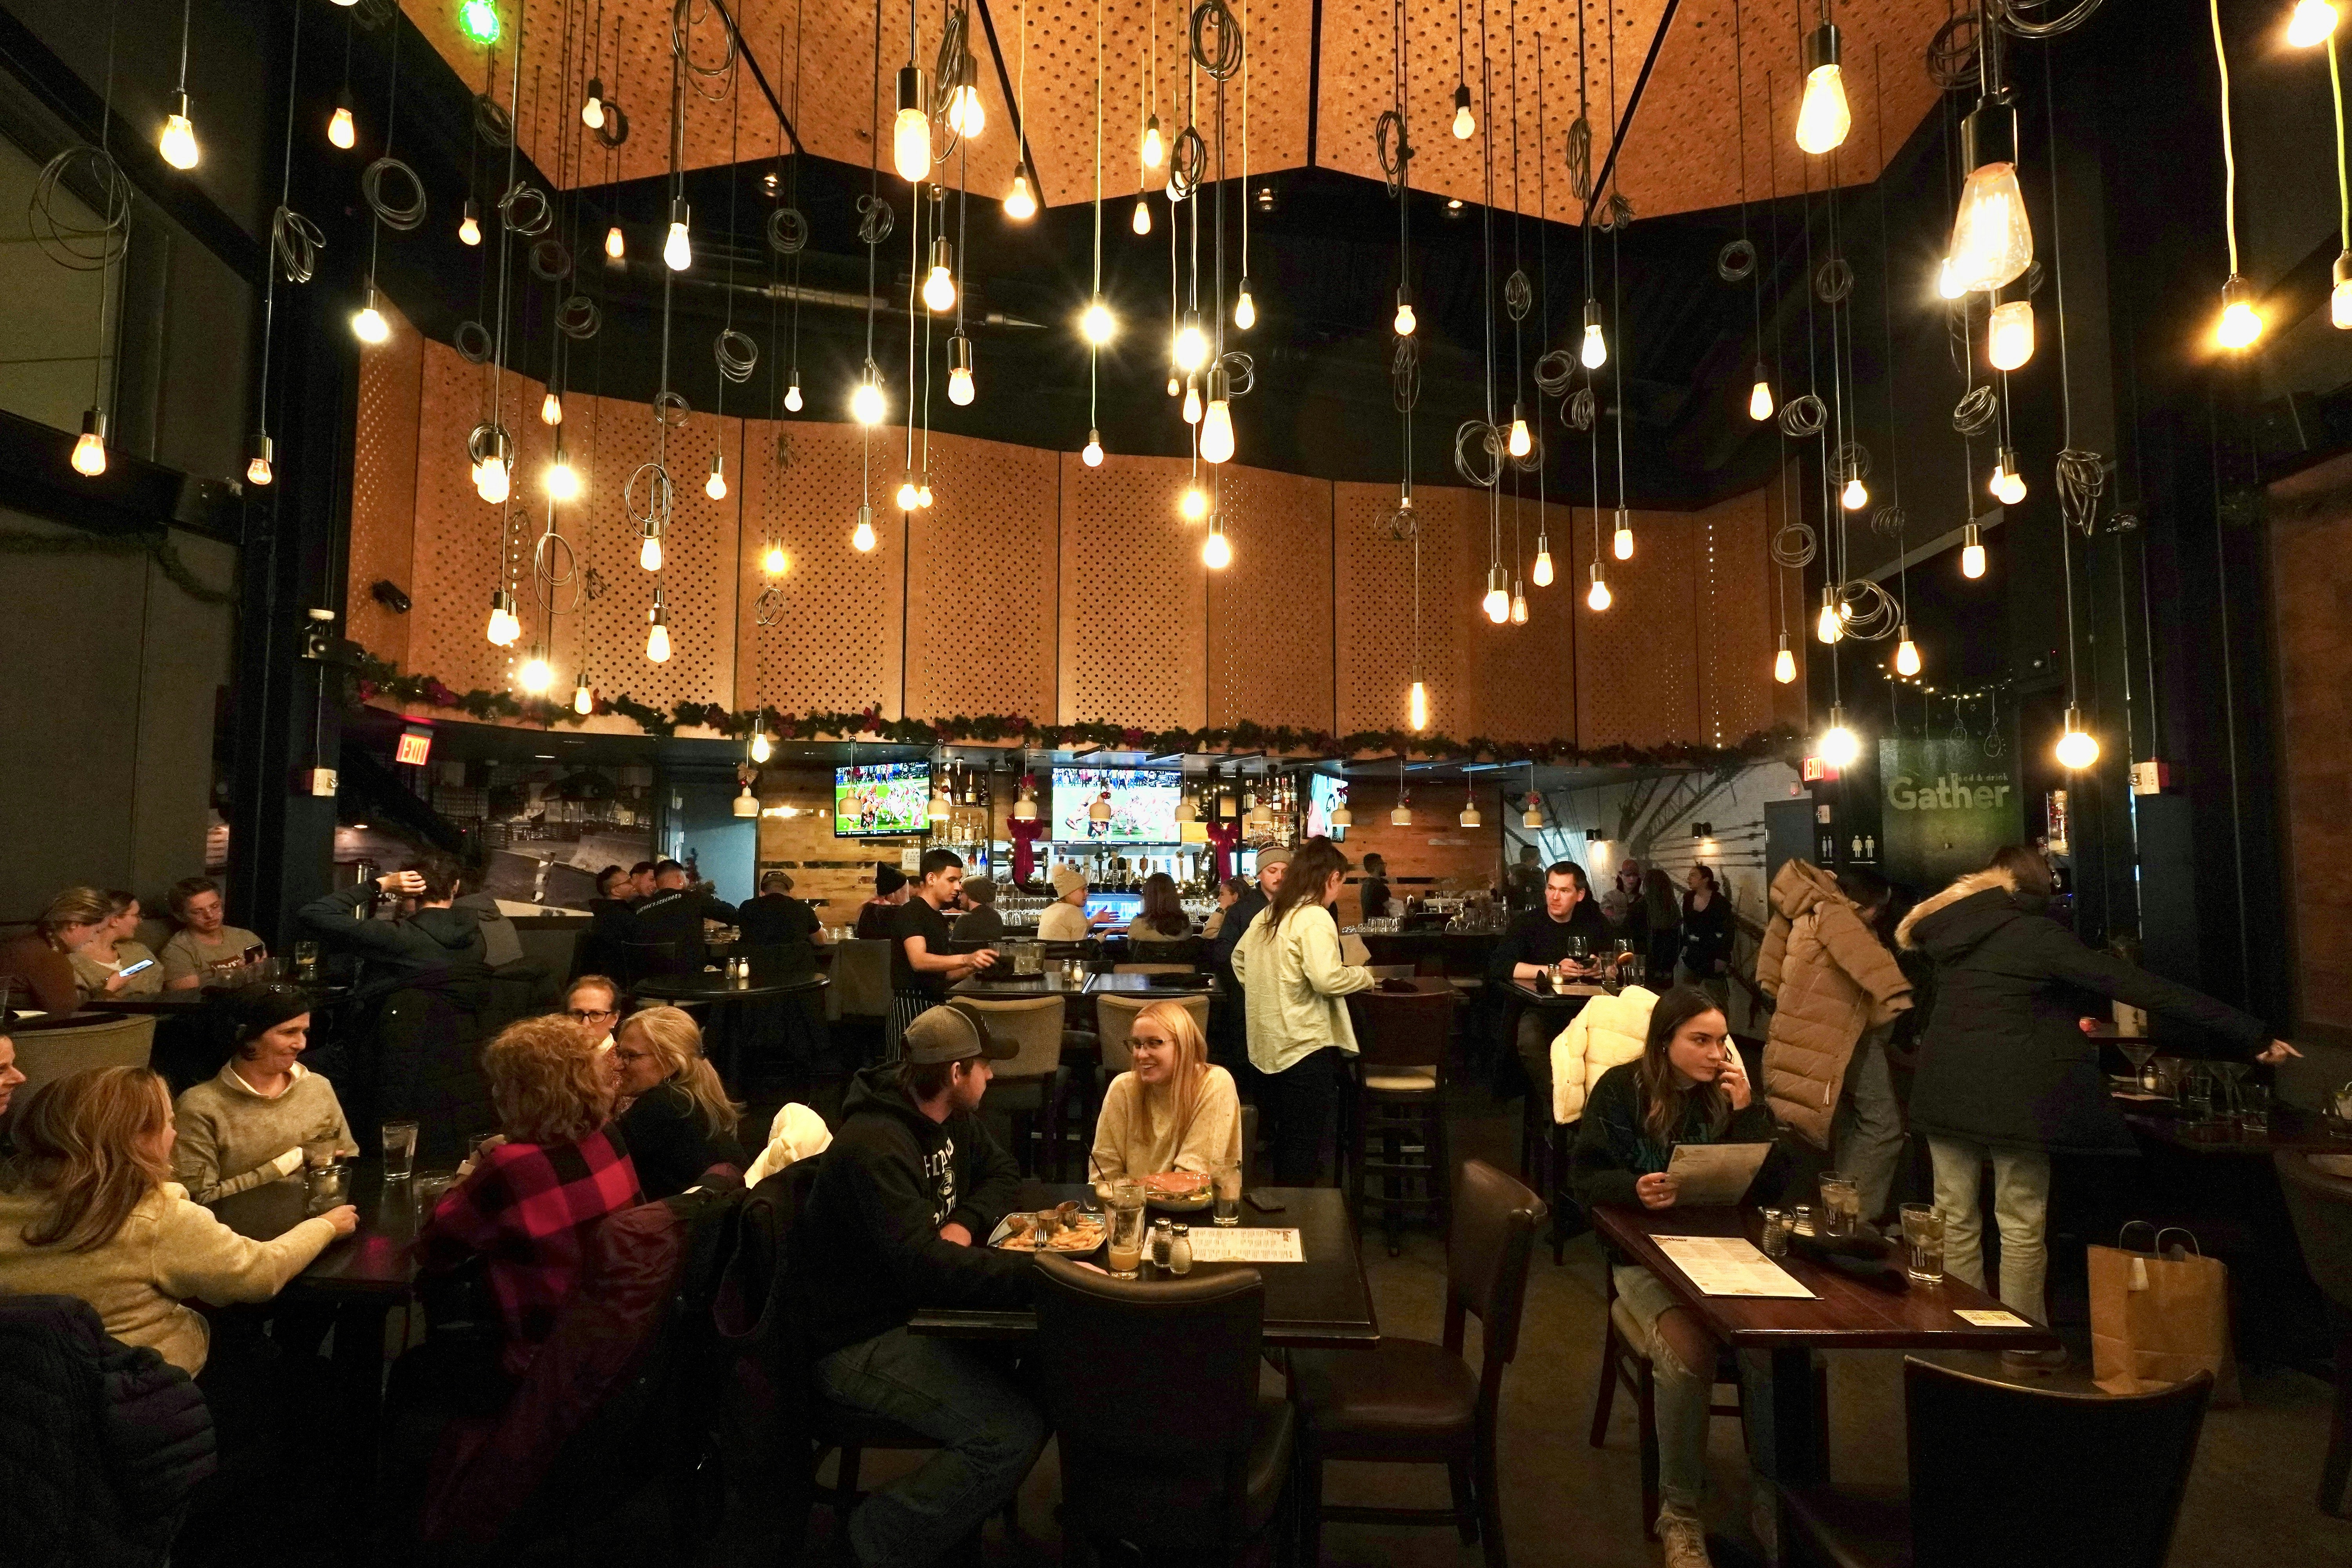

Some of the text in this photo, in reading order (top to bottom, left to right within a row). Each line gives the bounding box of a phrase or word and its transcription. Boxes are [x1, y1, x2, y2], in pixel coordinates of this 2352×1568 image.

[401, 737, 426, 763] EXIT
[1807, 757, 1821, 779] EXIT
[1888, 773, 2010, 810] Gather
